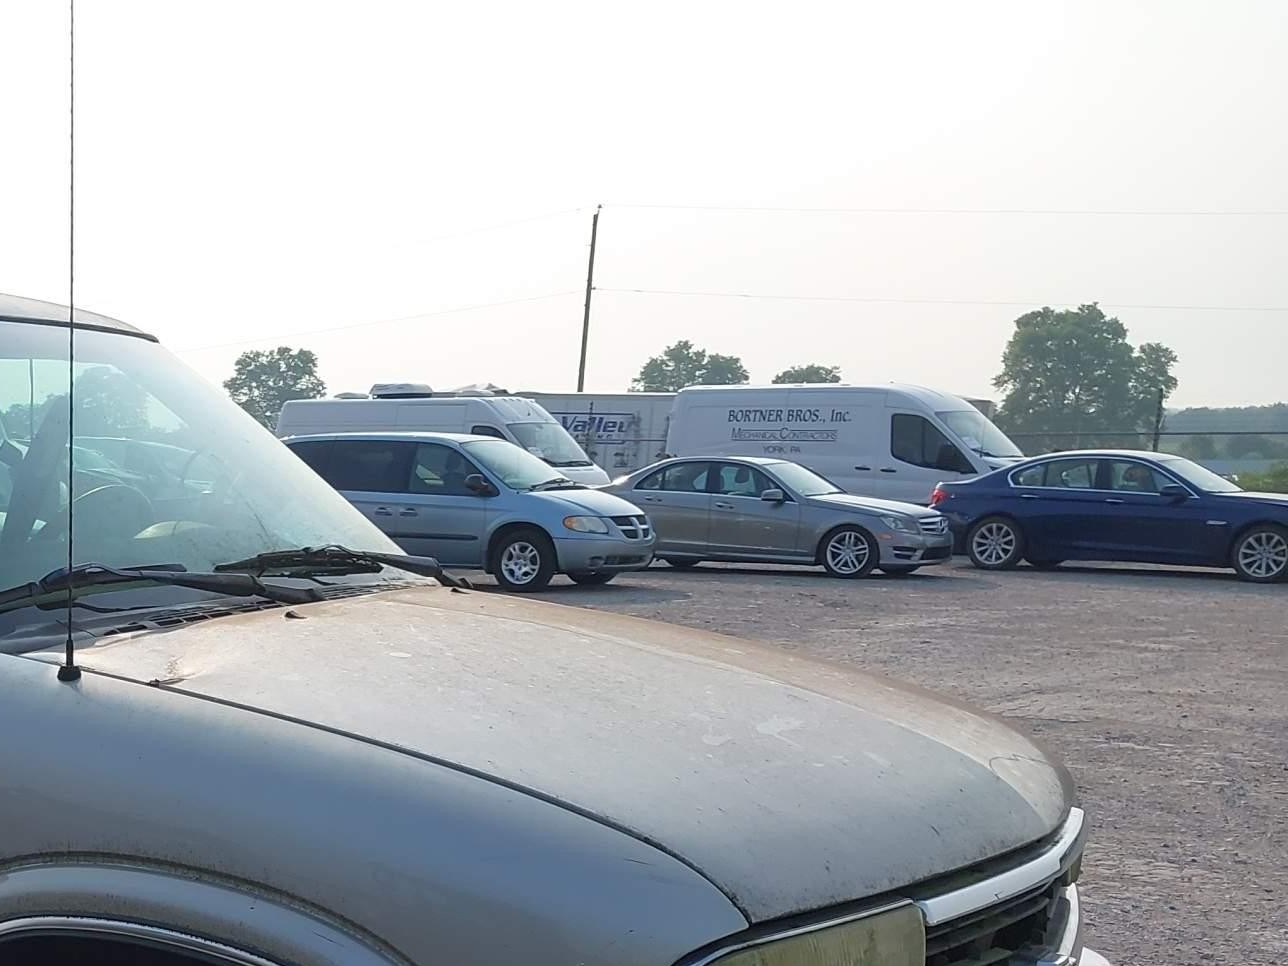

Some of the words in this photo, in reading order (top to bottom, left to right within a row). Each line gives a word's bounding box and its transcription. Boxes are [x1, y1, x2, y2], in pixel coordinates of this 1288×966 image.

[727, 409, 783, 423] BORTNER
[786, 408, 826, 424] BROS.,
[830, 409, 852, 423] Inc.
